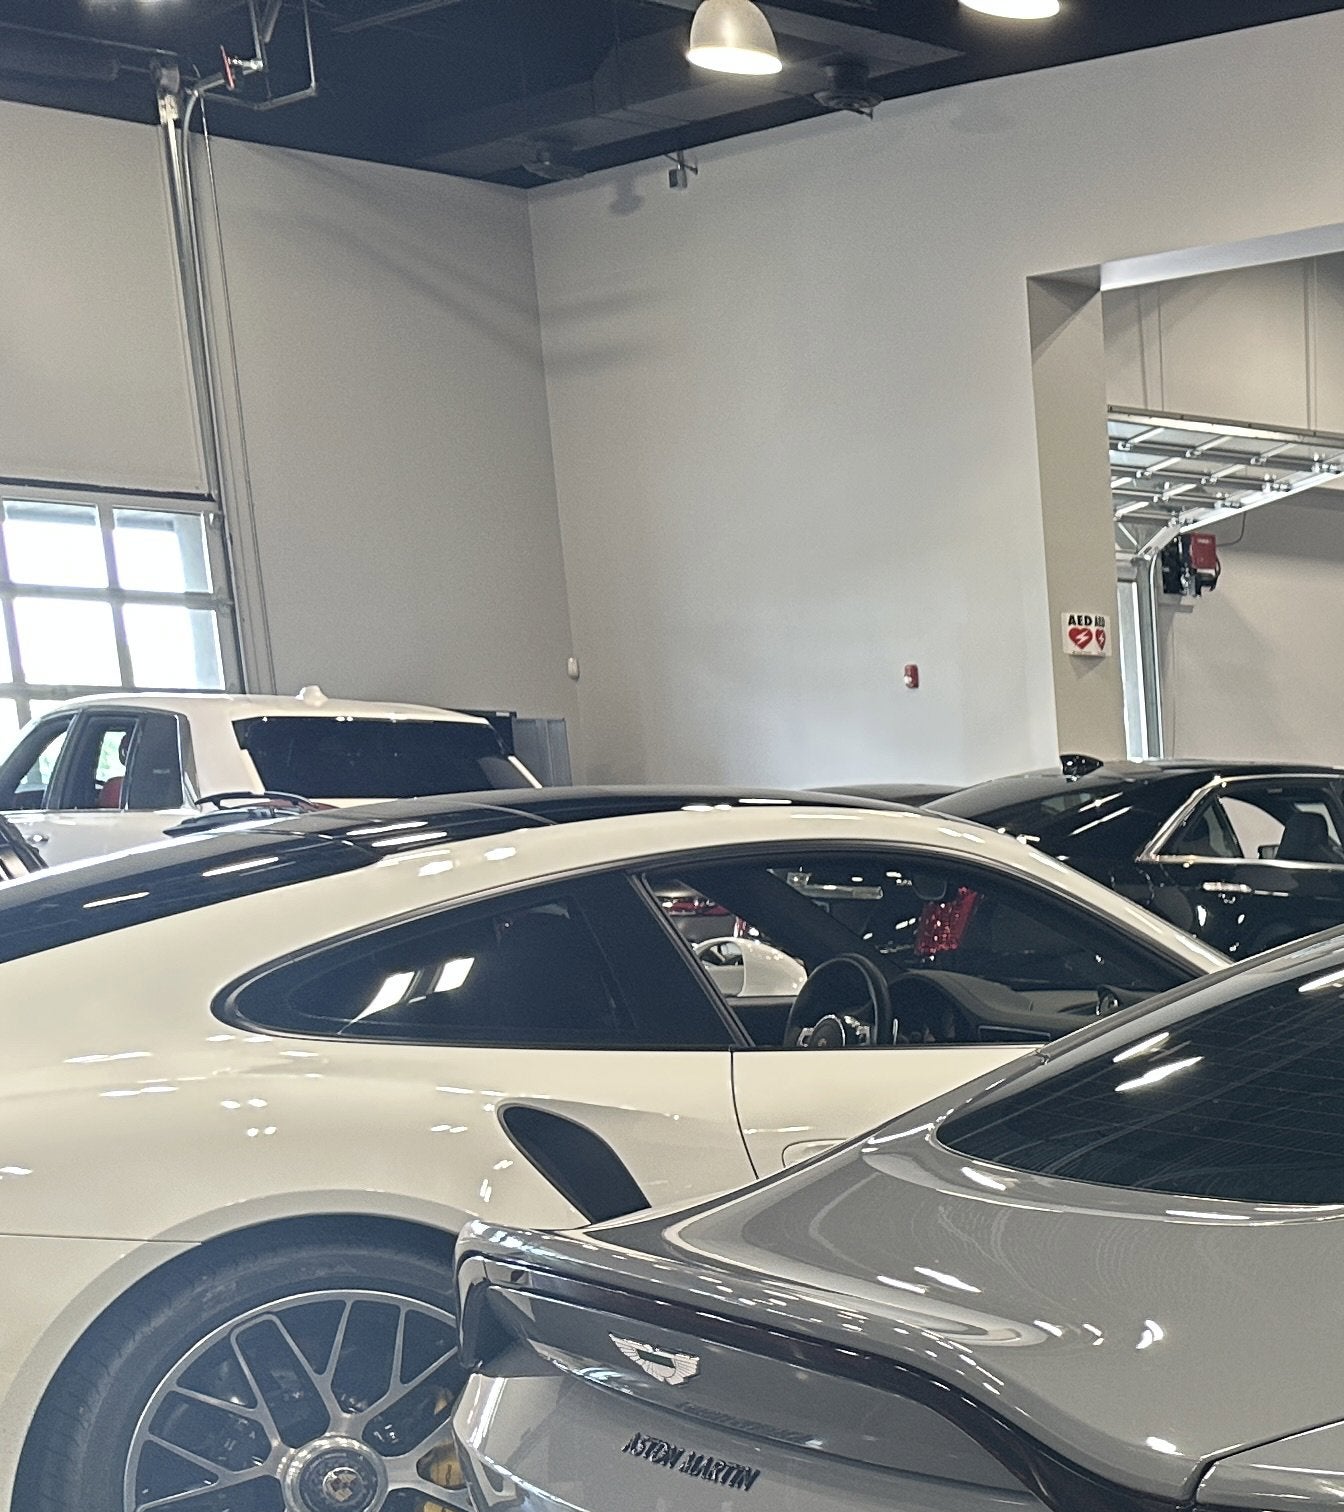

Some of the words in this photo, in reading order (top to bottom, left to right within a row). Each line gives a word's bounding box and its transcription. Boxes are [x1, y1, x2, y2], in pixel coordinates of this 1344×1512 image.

[1068, 614, 1093, 626] AED
[621, 1432, 686, 1469] ASTON
[678, 1451, 761, 1492] MARTIN
